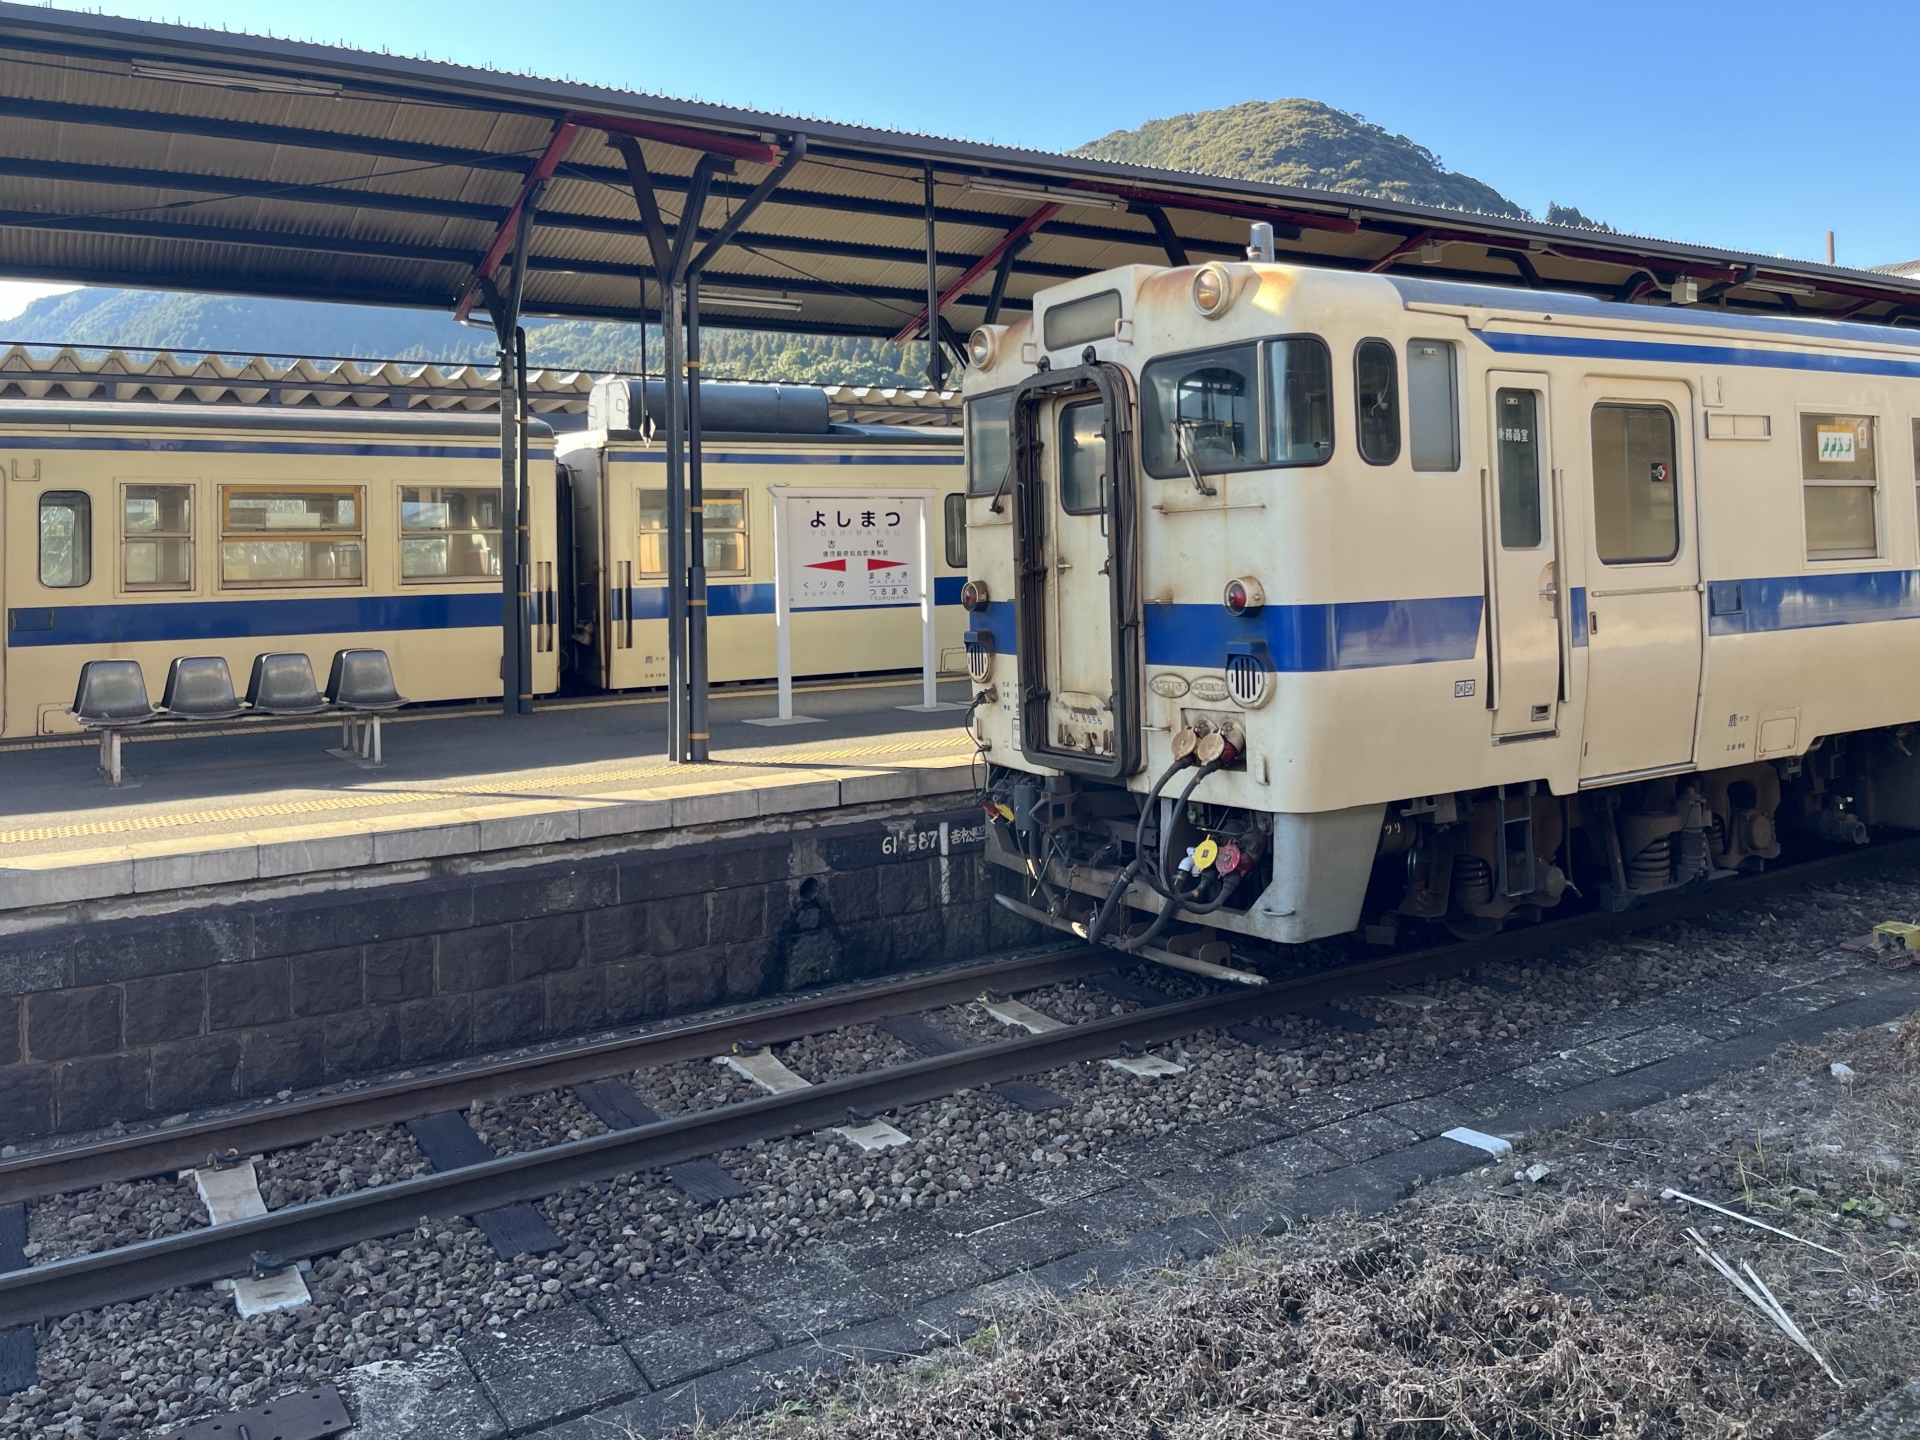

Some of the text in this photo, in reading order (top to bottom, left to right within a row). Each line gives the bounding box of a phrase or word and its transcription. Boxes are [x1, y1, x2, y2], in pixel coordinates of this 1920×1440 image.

[1497, 427, 1529, 442] 乗務員室
[810, 510, 901, 528] よしまつ
[811, 529, 900, 537] YOSHIMATSU
[827, 539, 884, 548] 吉松
[868, 571, 908, 580] まさき
[803, 581, 845, 589] くりの
[869, 588, 909, 596] つるまる
